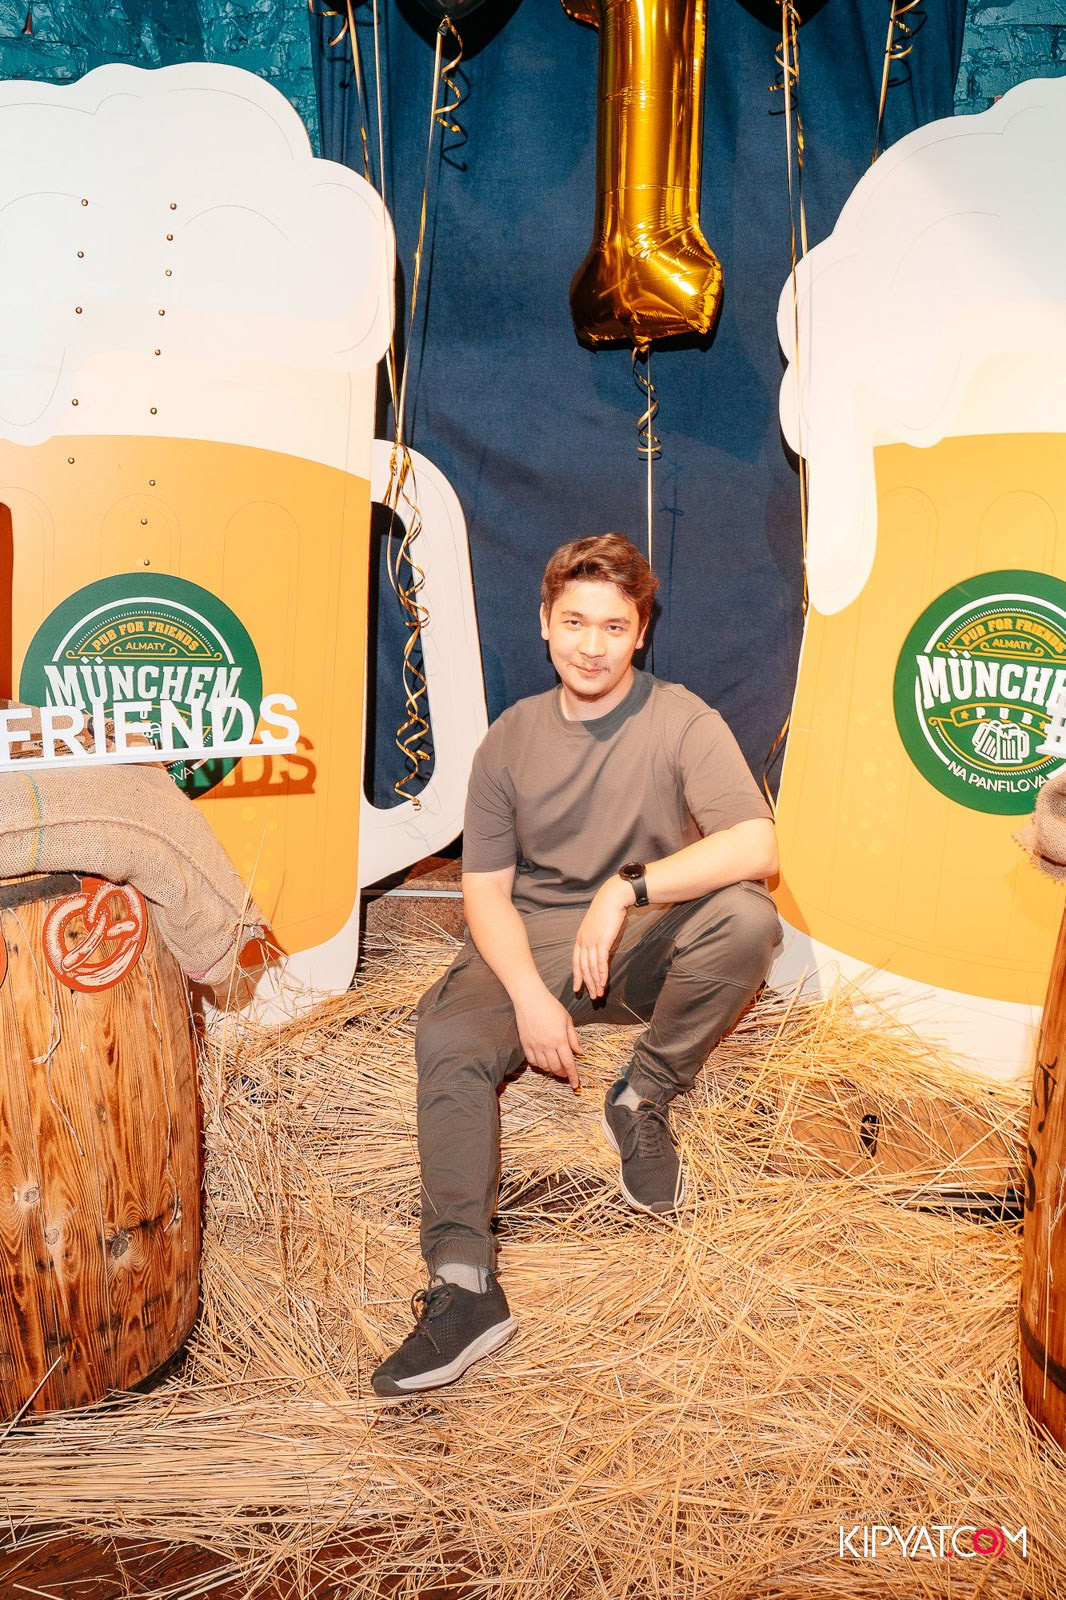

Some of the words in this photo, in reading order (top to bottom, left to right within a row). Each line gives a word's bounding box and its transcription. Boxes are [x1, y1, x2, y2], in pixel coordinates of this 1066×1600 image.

[91, 629, 117, 651] PUB
[118, 621, 145, 636] FOR
[148, 621, 200, 651] FRIENDS
[125, 642, 166, 650] ALMATY
[961, 624, 986, 646] PUB
[987, 618, 1013, 632] FOR
[992, 638, 1033, 650] ALMATY
[44, 655, 242, 720] MÜNCHEN
[976, 707, 1033, 725] PUB
[948, 761, 967, 781] NA
[968, 772, 1047, 793] PANFILOVA
